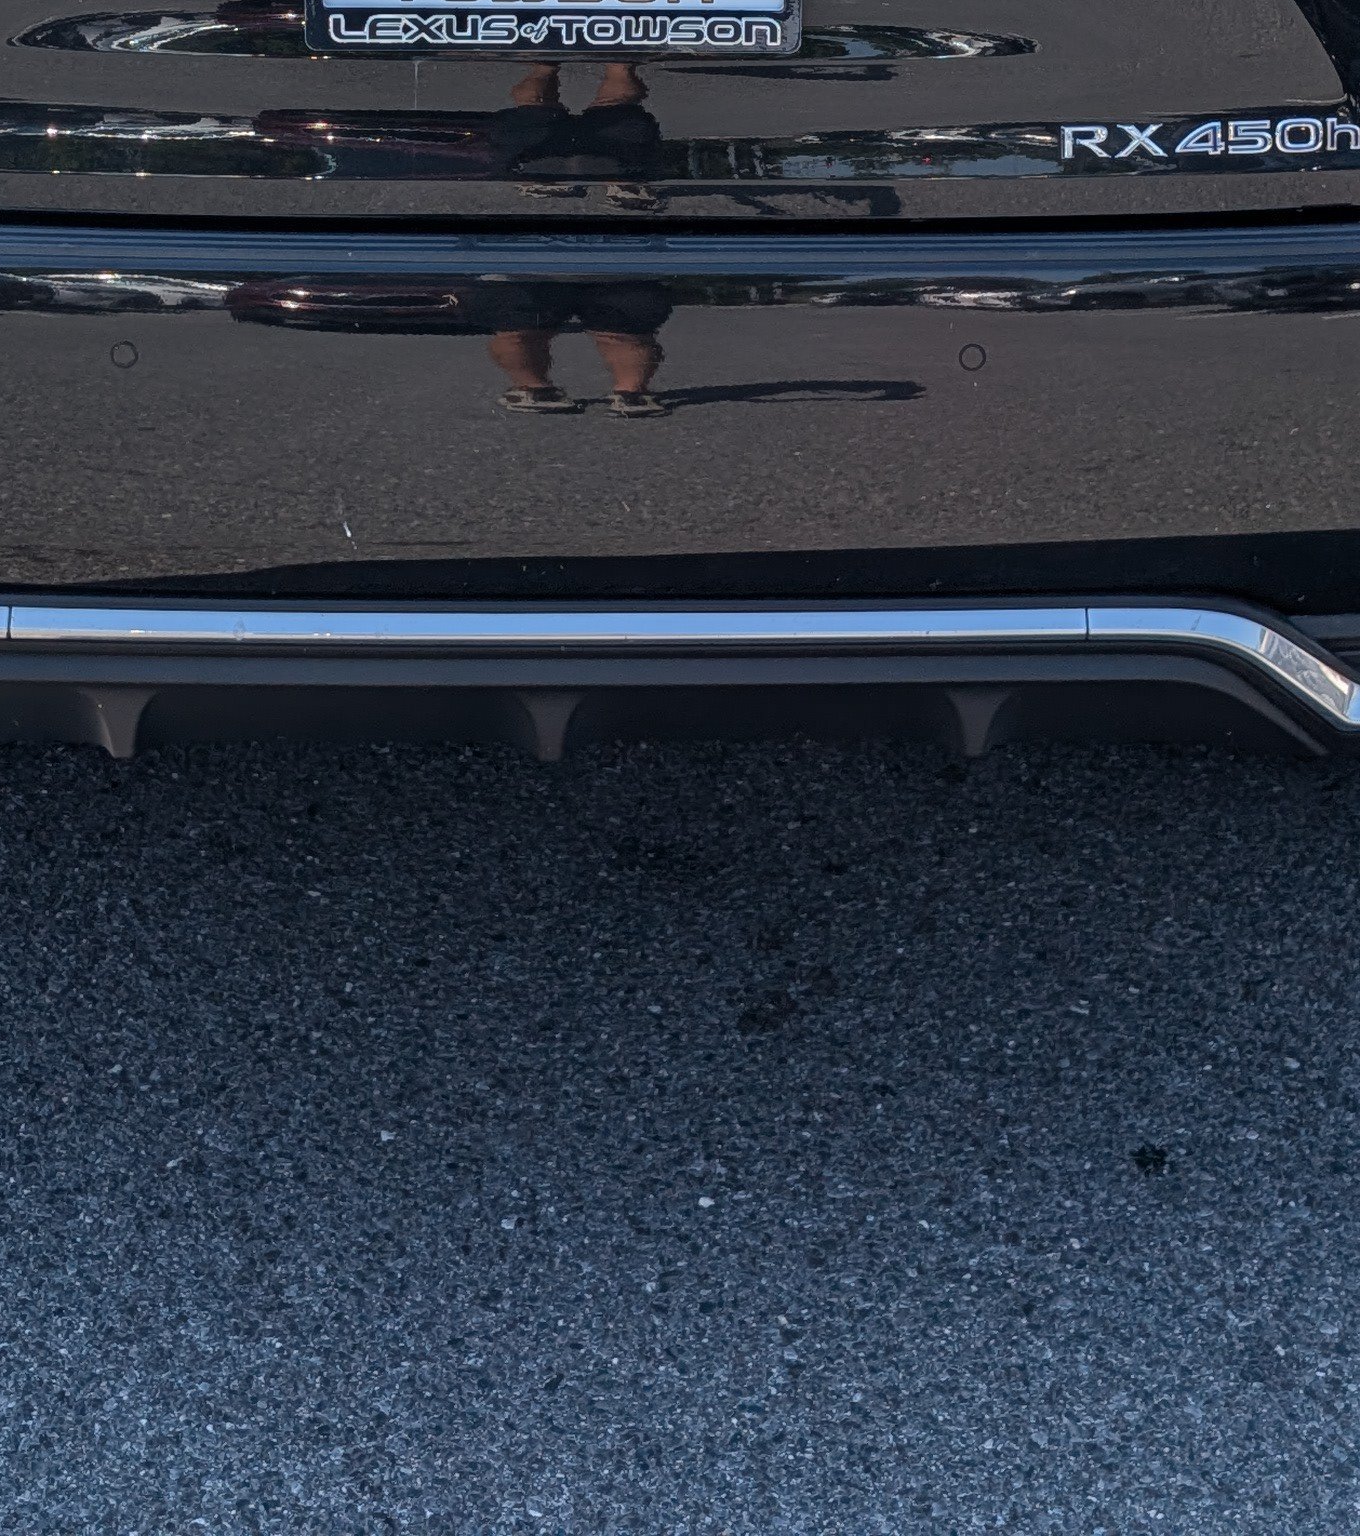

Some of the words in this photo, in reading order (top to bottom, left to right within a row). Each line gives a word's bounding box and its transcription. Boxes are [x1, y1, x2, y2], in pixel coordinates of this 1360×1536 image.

[328, 14, 520, 44] LEXUS
[522, 20, 548, 44] of
[548, 16, 782, 46] TOWSON
